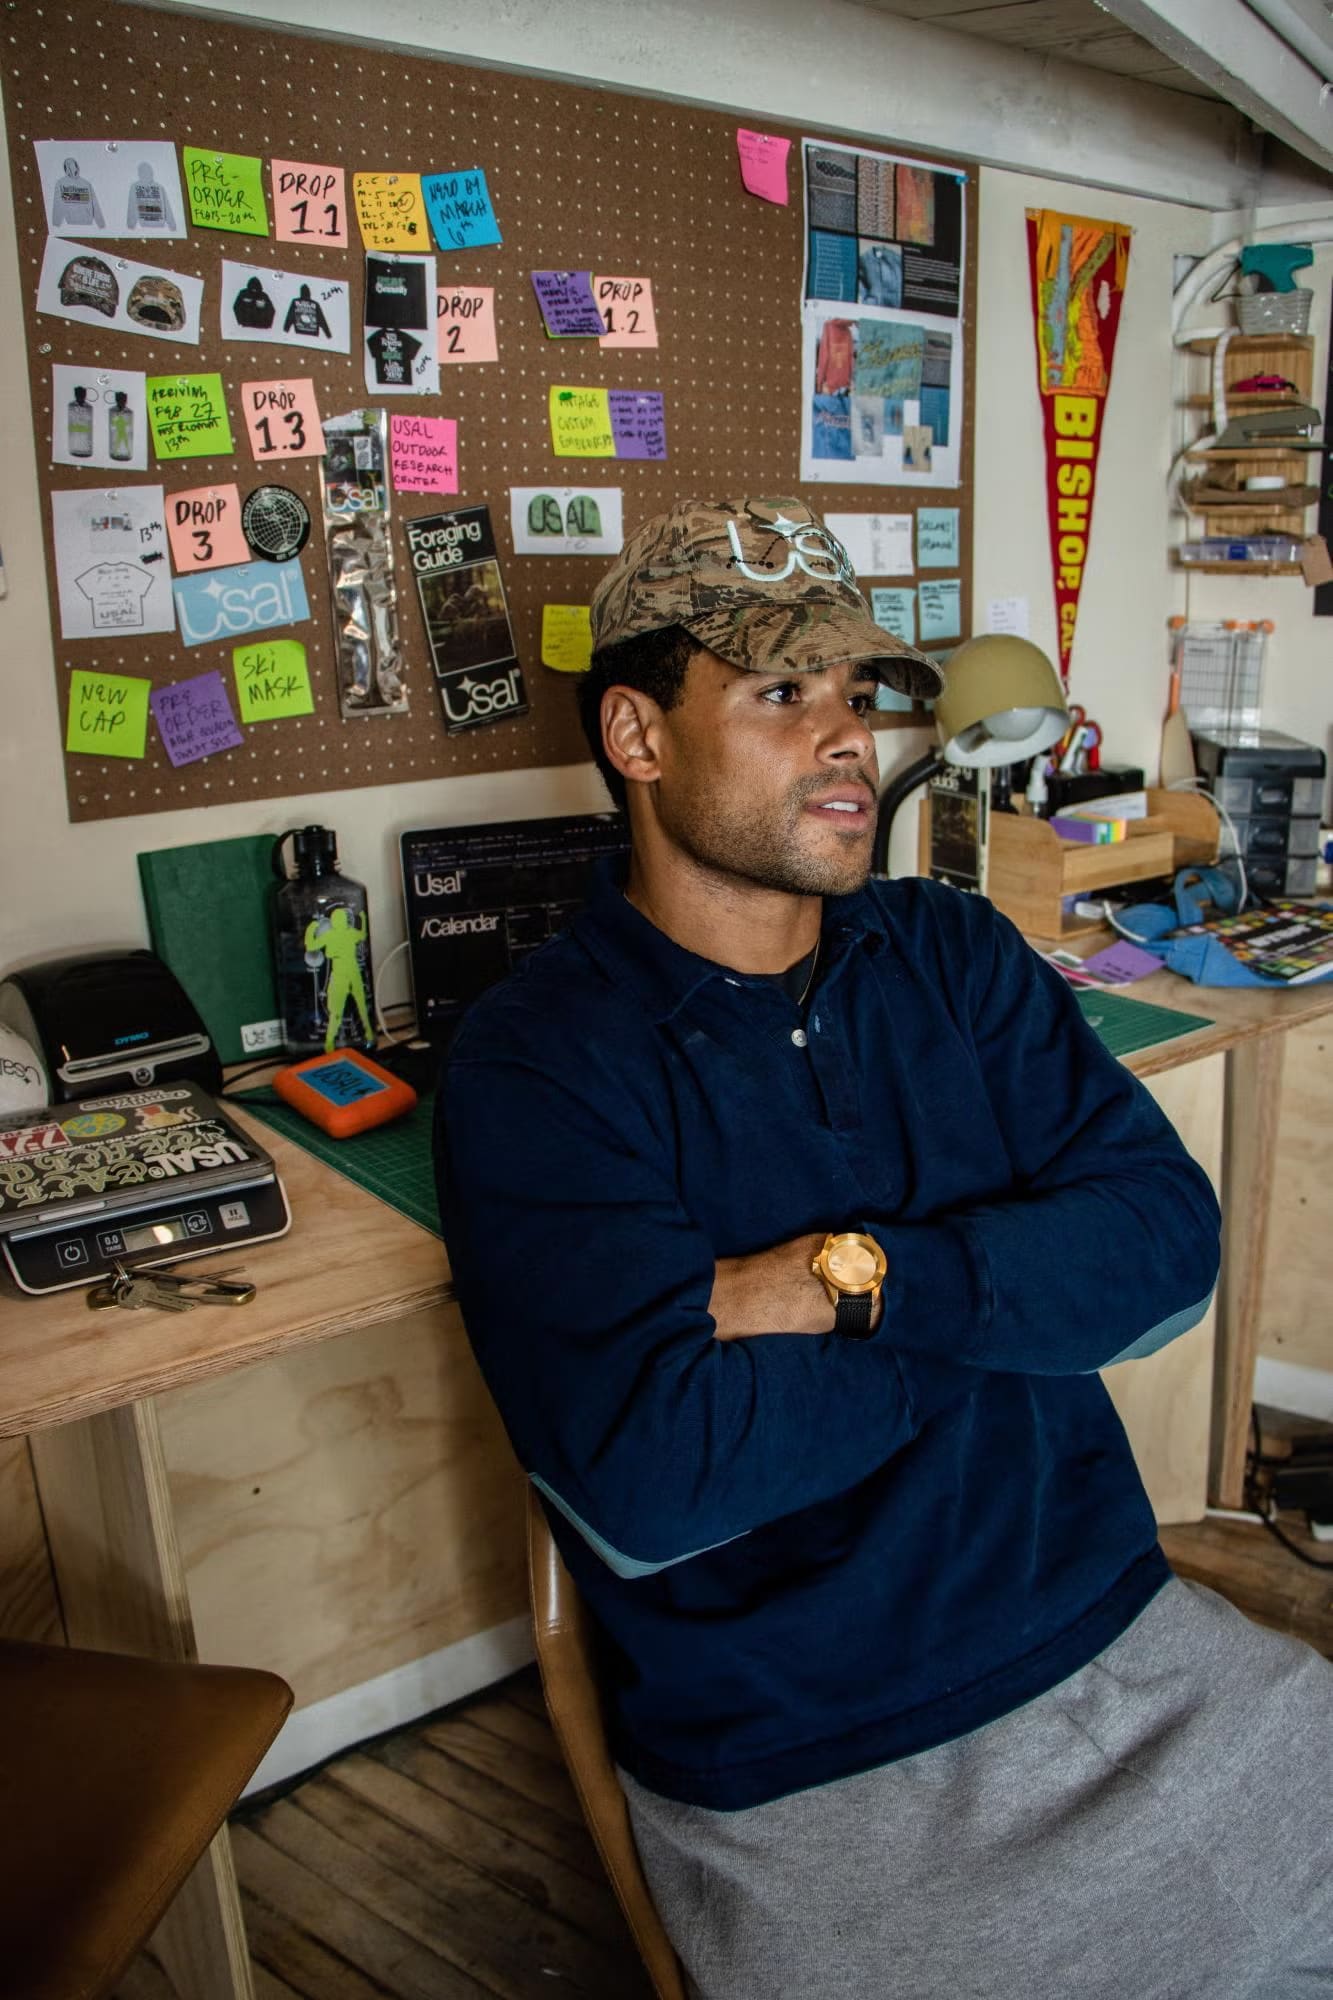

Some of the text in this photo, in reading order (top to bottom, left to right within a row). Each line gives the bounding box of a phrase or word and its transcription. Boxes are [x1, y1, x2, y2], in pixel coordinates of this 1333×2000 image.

[278, 172, 336, 199] DROP
[193, 187, 253, 210] ORDER
[290, 200, 341, 236] 1.1
[440, 199, 488, 224] MARCH
[600, 281, 643, 301] DROP
[437, 295, 483, 318] DROP
[603, 307, 646, 334] 1.2
[447, 325, 465, 353] 2
[190, 402, 215, 419] 27
[253, 390, 296, 411] DROP
[255, 411, 306, 453] 1.3
[393, 419, 433, 439] USAL
[392, 440, 447, 456] OUTDOOR
[394, 460, 453, 475] RESEARCH
[394, 474, 439, 486] CENTER
[175, 499, 227, 526] DROP
[528, 498, 596, 534] USAL
[192, 531, 214, 561] 3
[408, 521, 482, 551] Foraging
[413, 545, 463, 571] Guide
[80, 683, 128, 705] NEW
[248, 676, 305, 705] MASK
[79, 711, 126, 734] CAP
[165, 700, 225, 733] ORDER
